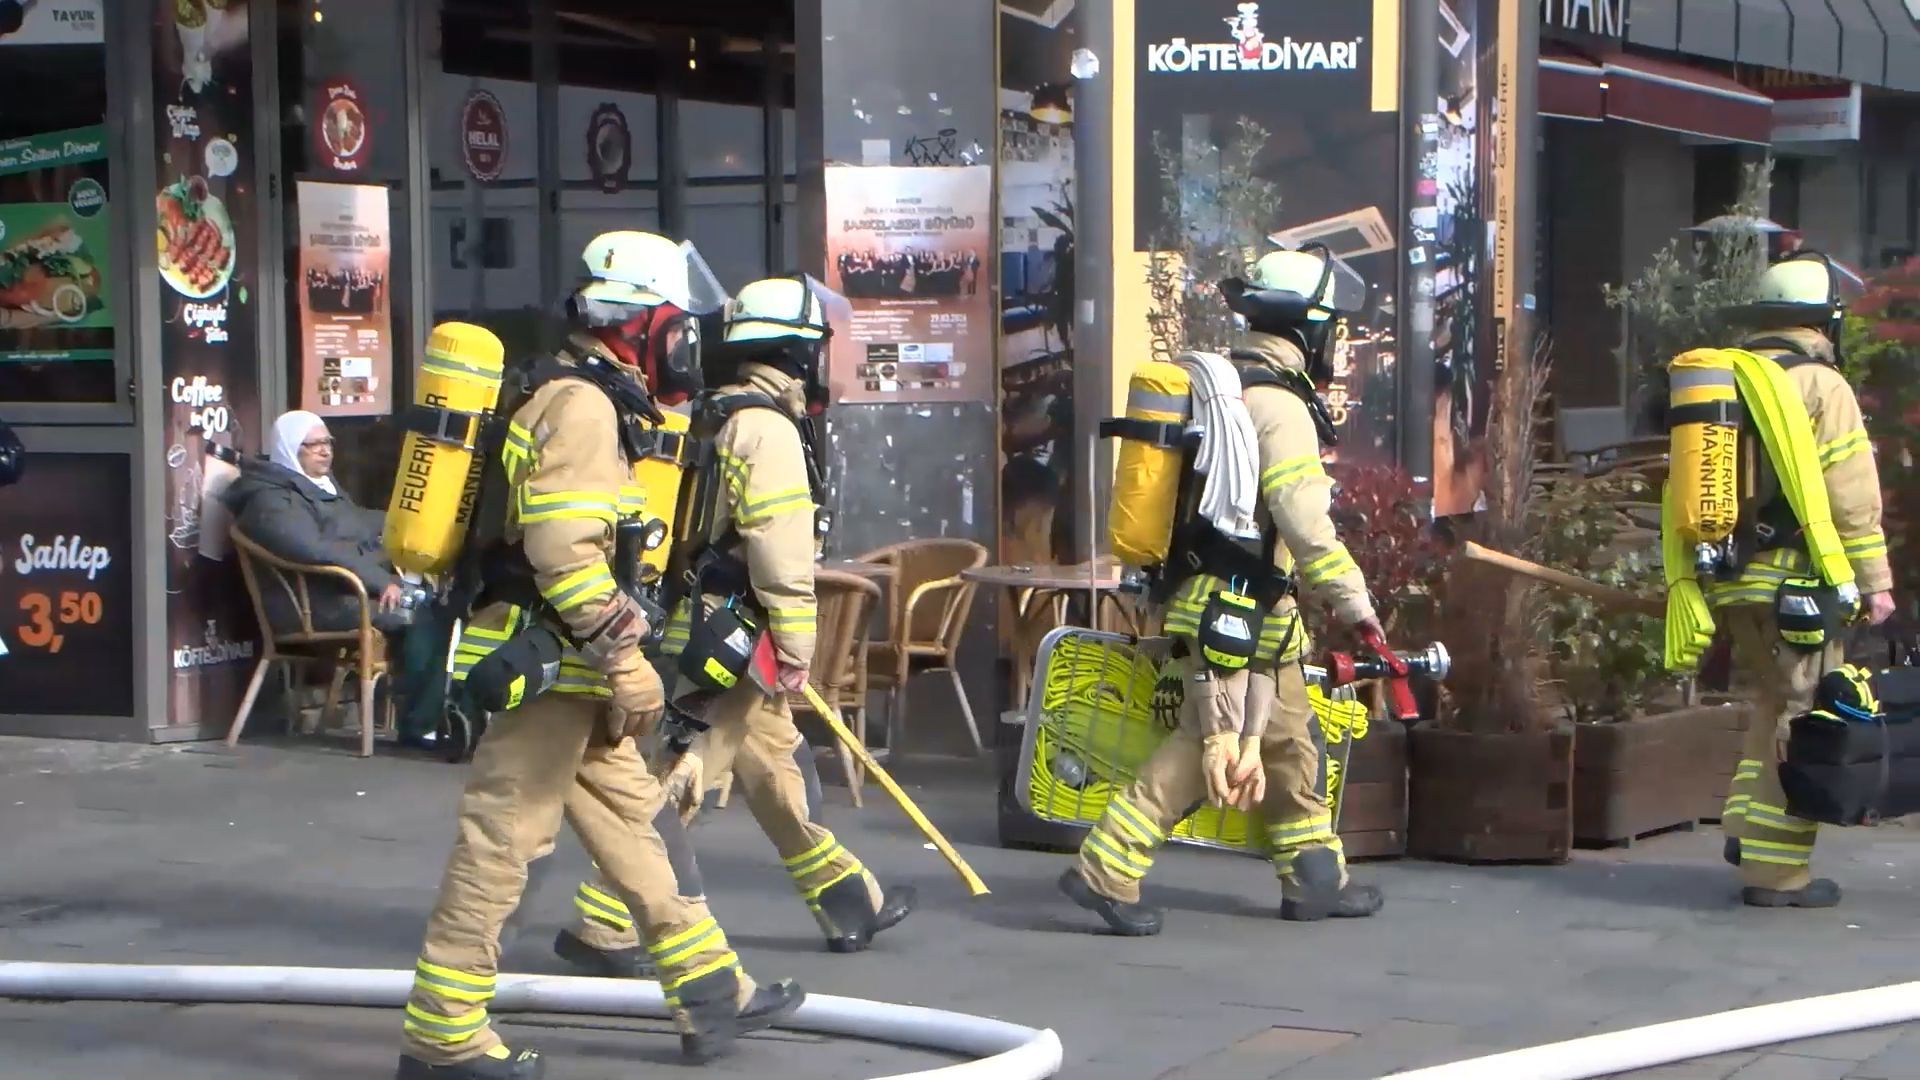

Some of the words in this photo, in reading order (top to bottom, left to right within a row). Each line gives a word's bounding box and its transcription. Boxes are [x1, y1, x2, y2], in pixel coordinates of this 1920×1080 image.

[1148, 38, 1239, 72] KÖFTE
[1262, 36, 1357, 70] DİYARI
[468, 131, 500, 147] HELAL
[171, 375, 223, 407] Coffee
[399, 392, 449, 514] FEUERWR
[1700, 423, 1718, 533] MANNHEIM
[15, 533, 111, 580] Sahlep
